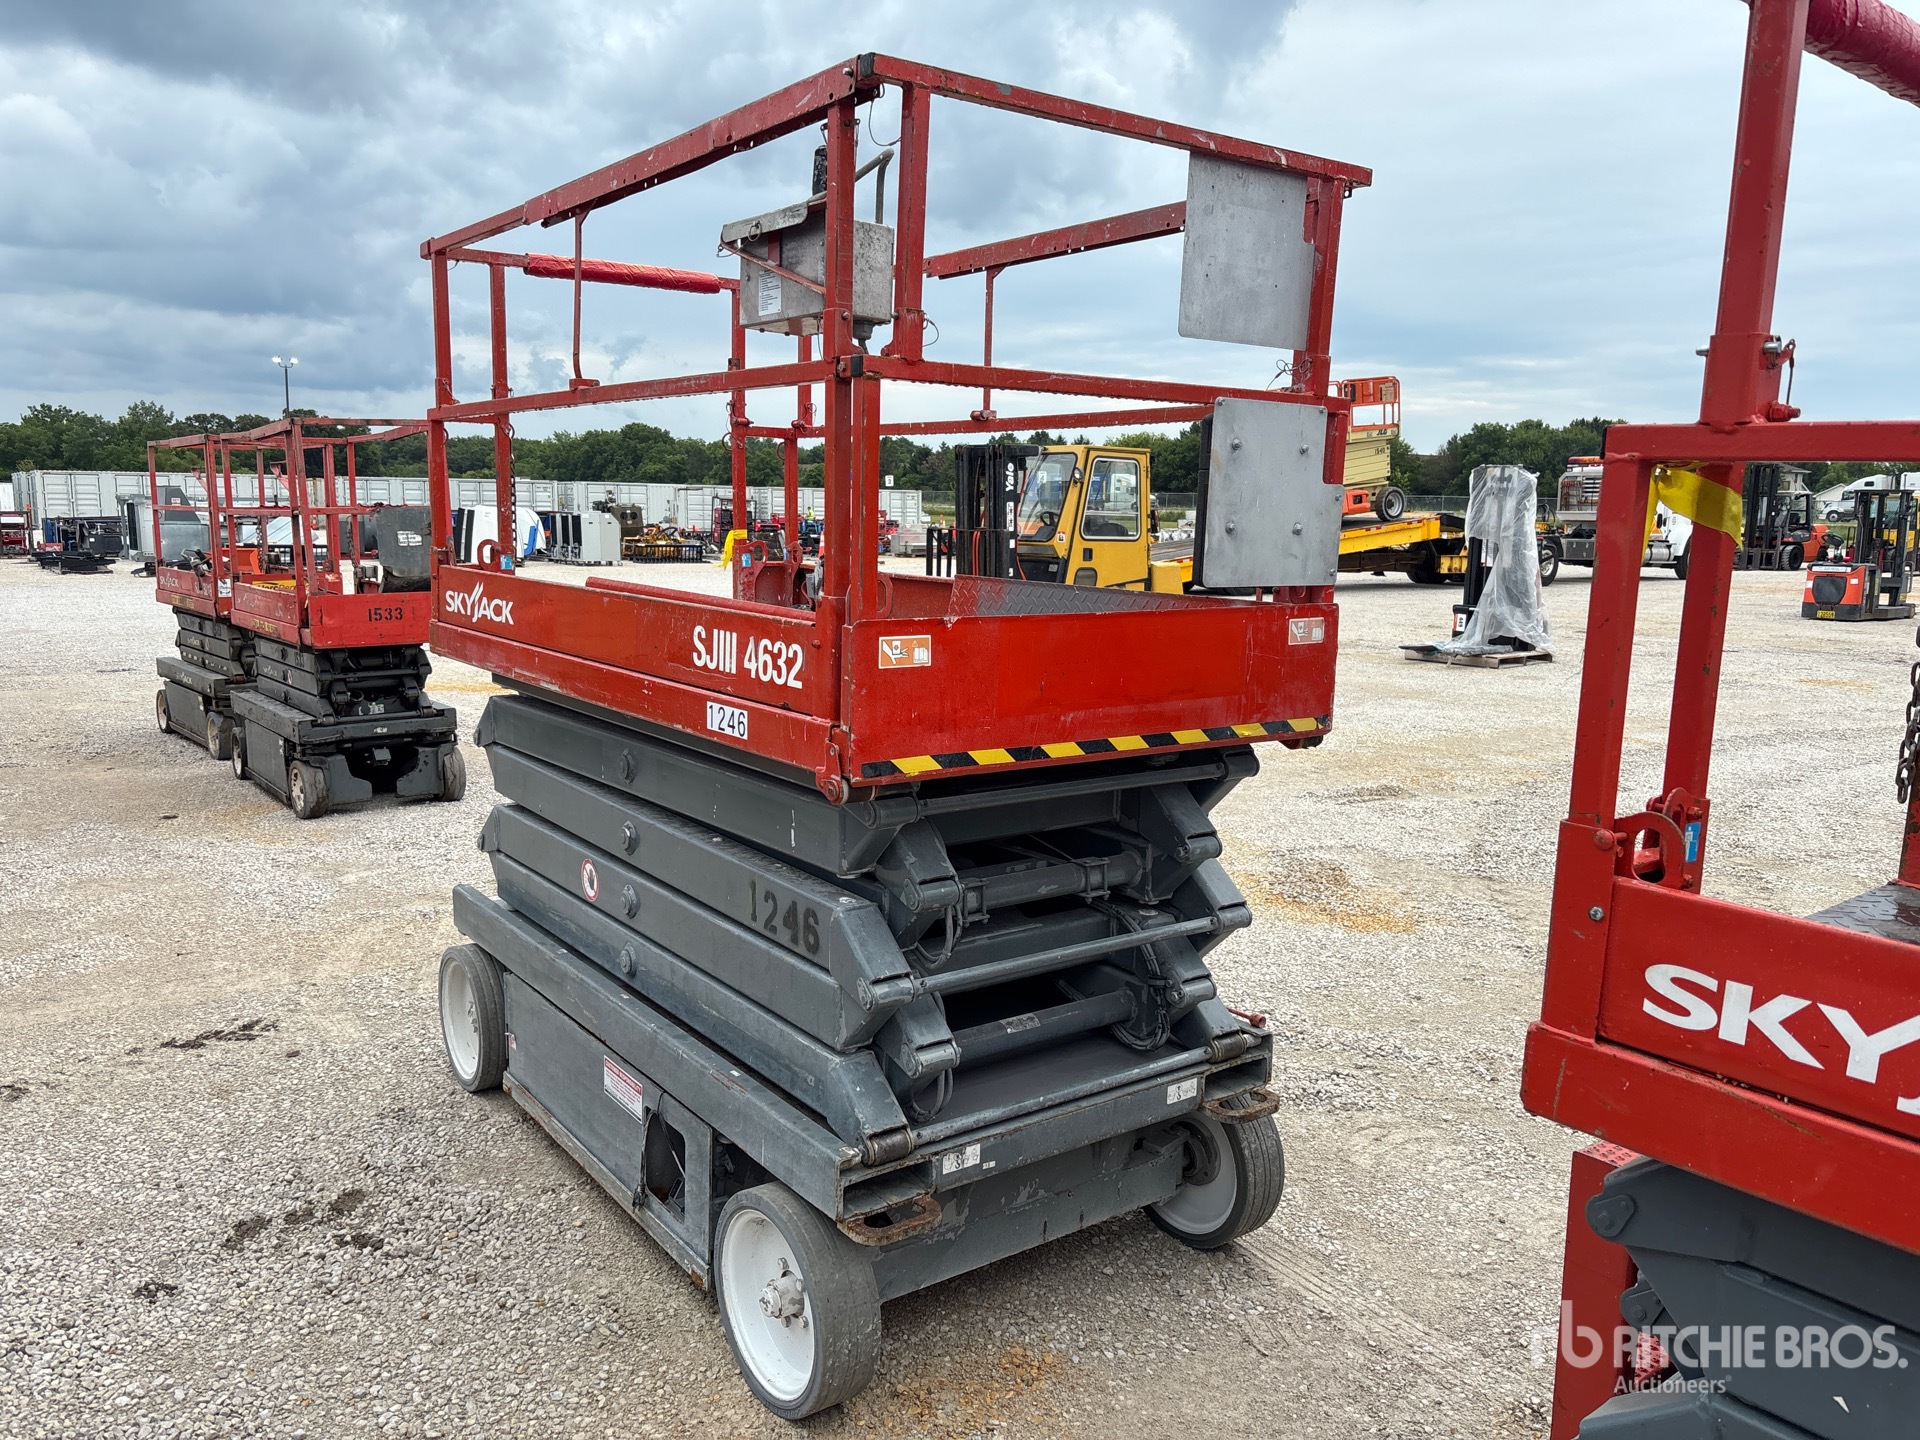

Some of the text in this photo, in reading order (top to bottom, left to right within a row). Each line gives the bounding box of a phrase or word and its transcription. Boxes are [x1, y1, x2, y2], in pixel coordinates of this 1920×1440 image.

[1005, 462, 1015, 492] Yale
[368, 607, 404, 622] 1533
[445, 581, 514, 625] SKYJACK
[693, 625, 803, 689] SJIII 4632
[709, 704, 746, 738] 1246
[749, 879, 820, 955] 1246
[1642, 963, 1920, 1116] SKY
